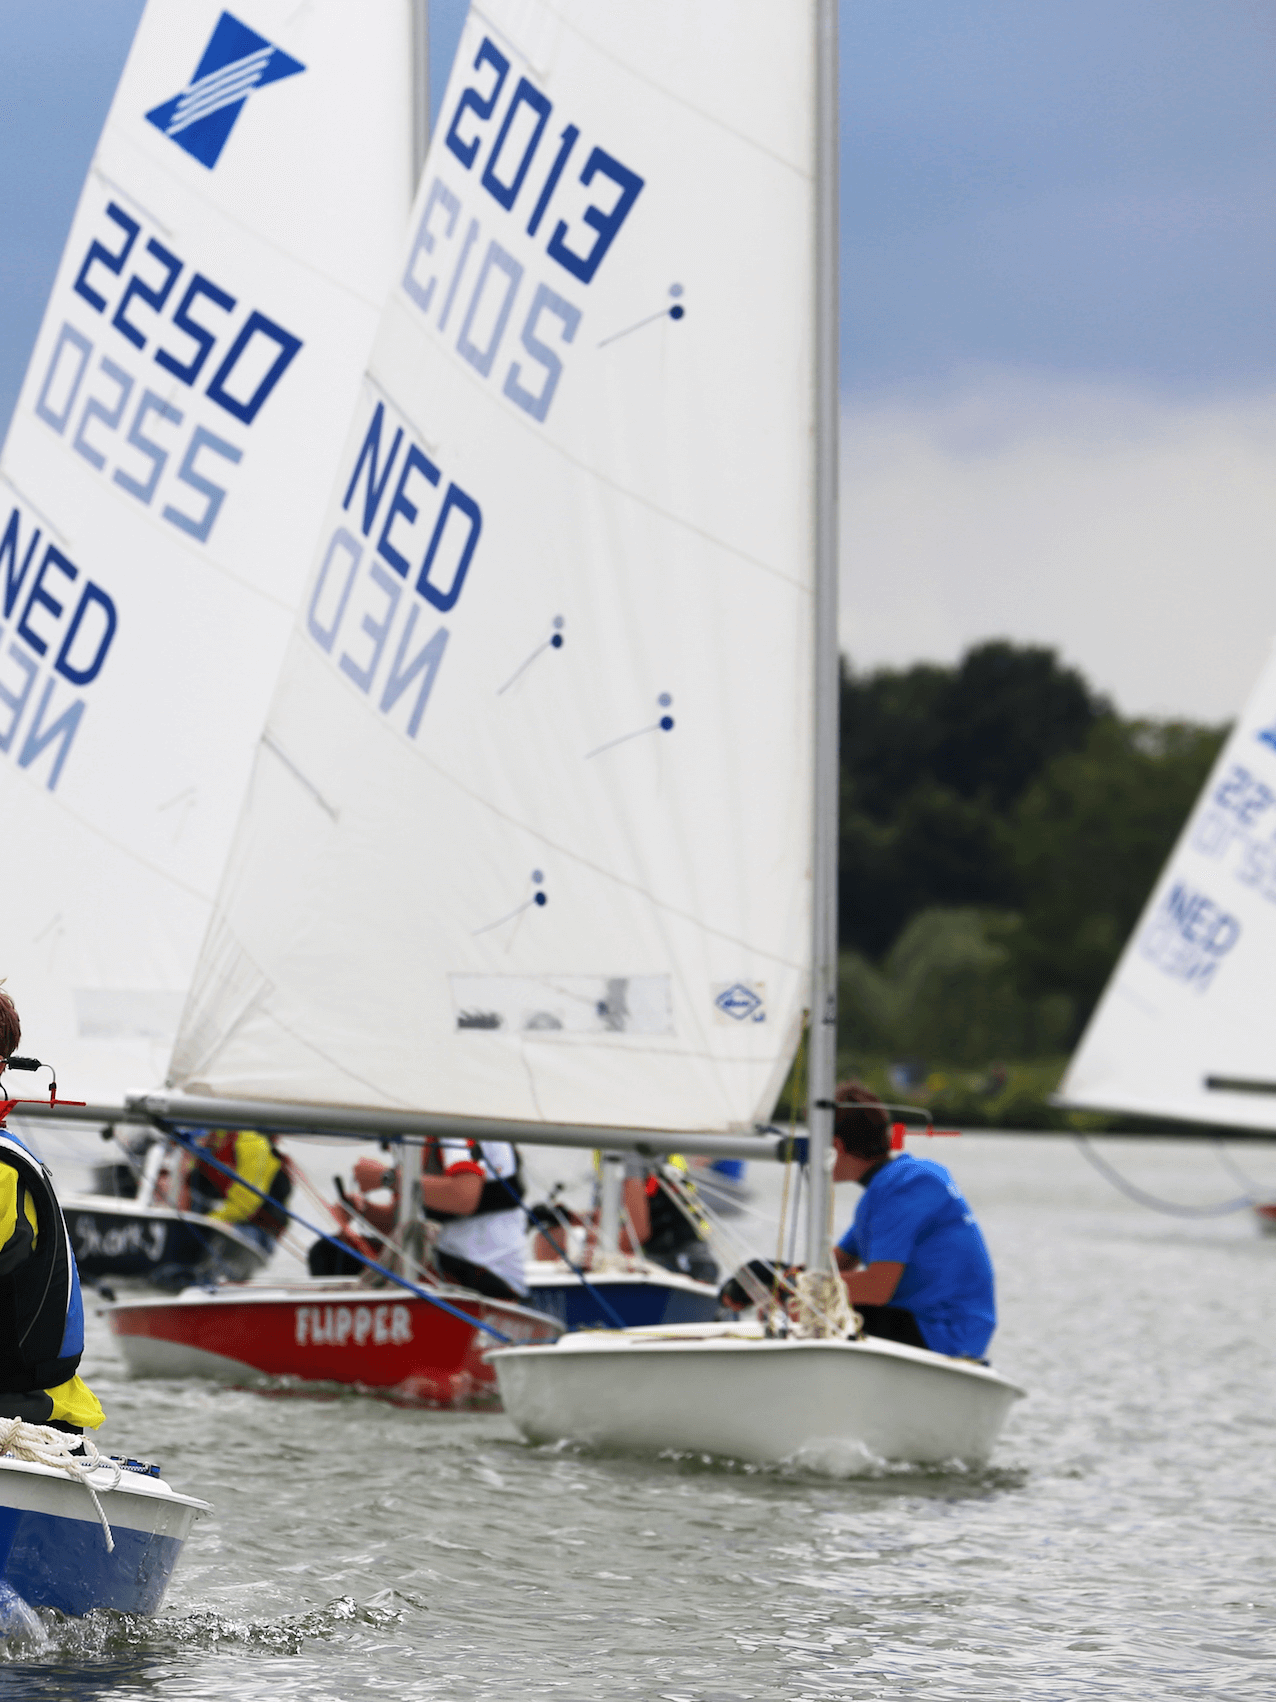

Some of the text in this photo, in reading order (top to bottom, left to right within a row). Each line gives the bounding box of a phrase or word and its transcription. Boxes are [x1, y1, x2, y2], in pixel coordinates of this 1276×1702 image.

[444, 35, 646, 286] 2013
[73, 200, 305, 427] 2250
[340, 401, 483, 612] NED
[295, 1304, 414, 1347] FLIPPER
